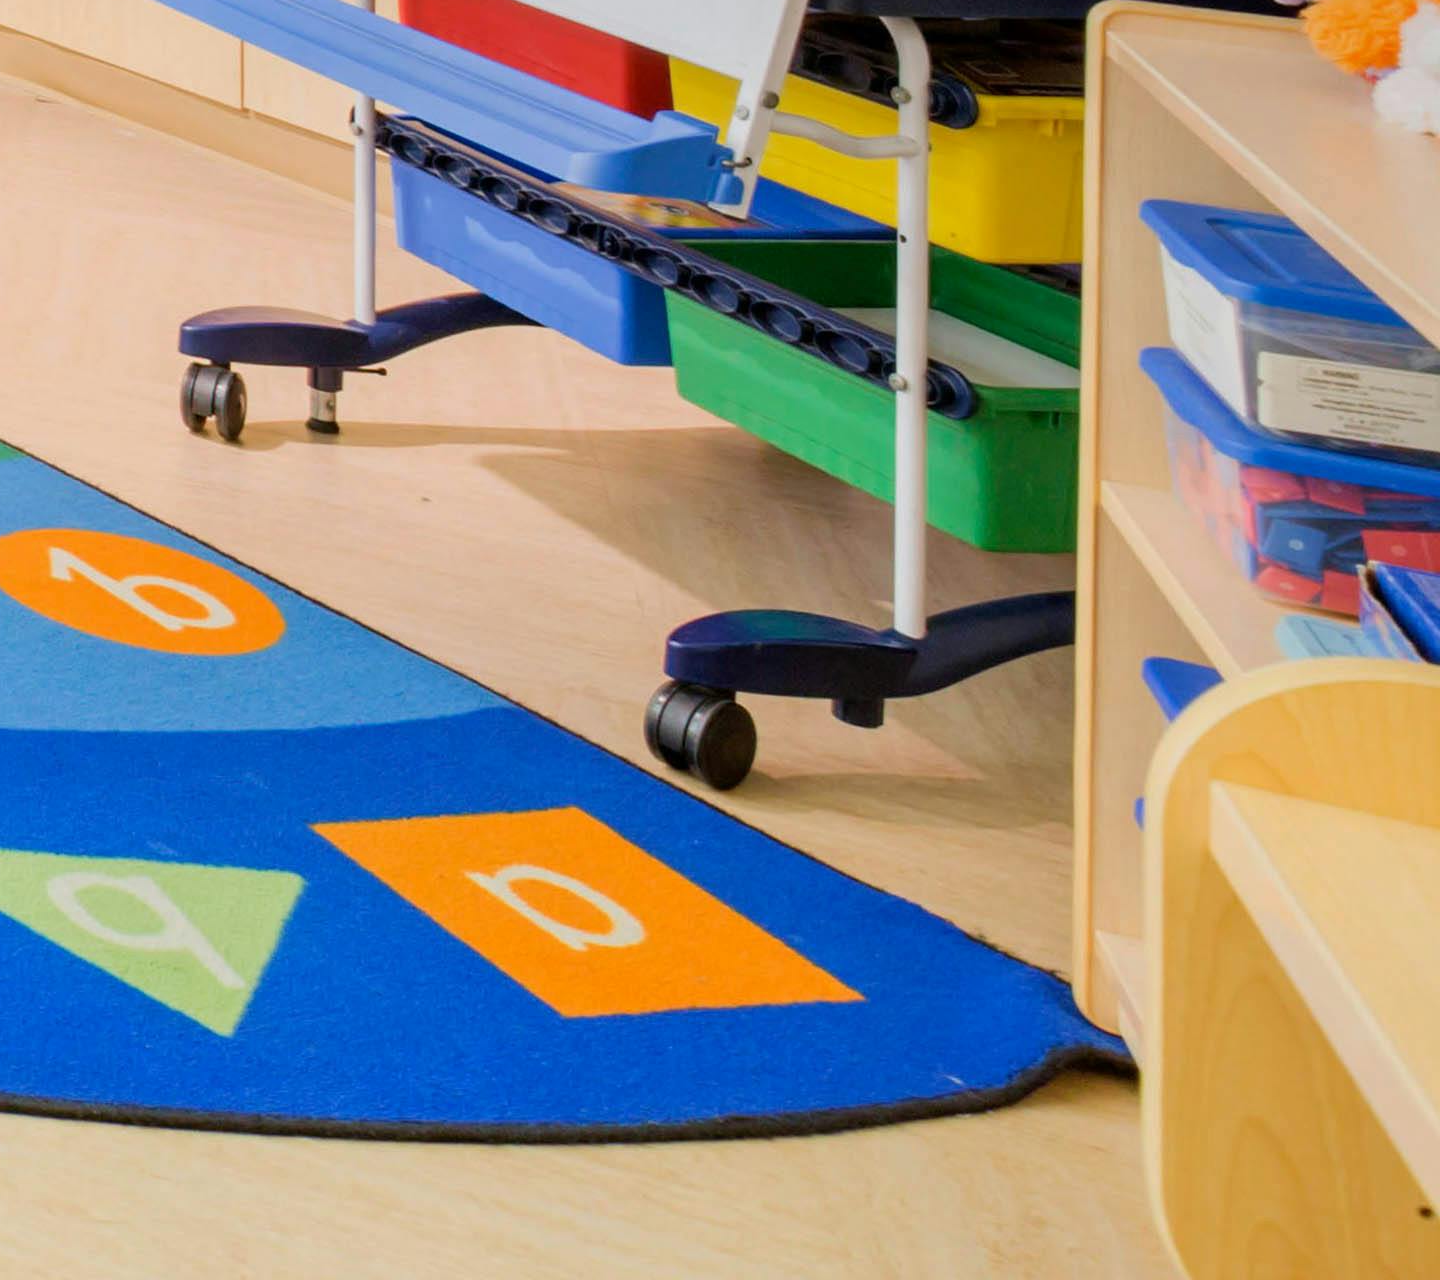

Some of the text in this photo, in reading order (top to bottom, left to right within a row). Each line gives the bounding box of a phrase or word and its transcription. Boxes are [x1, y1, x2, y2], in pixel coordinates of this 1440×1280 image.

[48, 548, 235, 632] q
[48, 871, 245, 991] b
[465, 864, 645, 955] a
